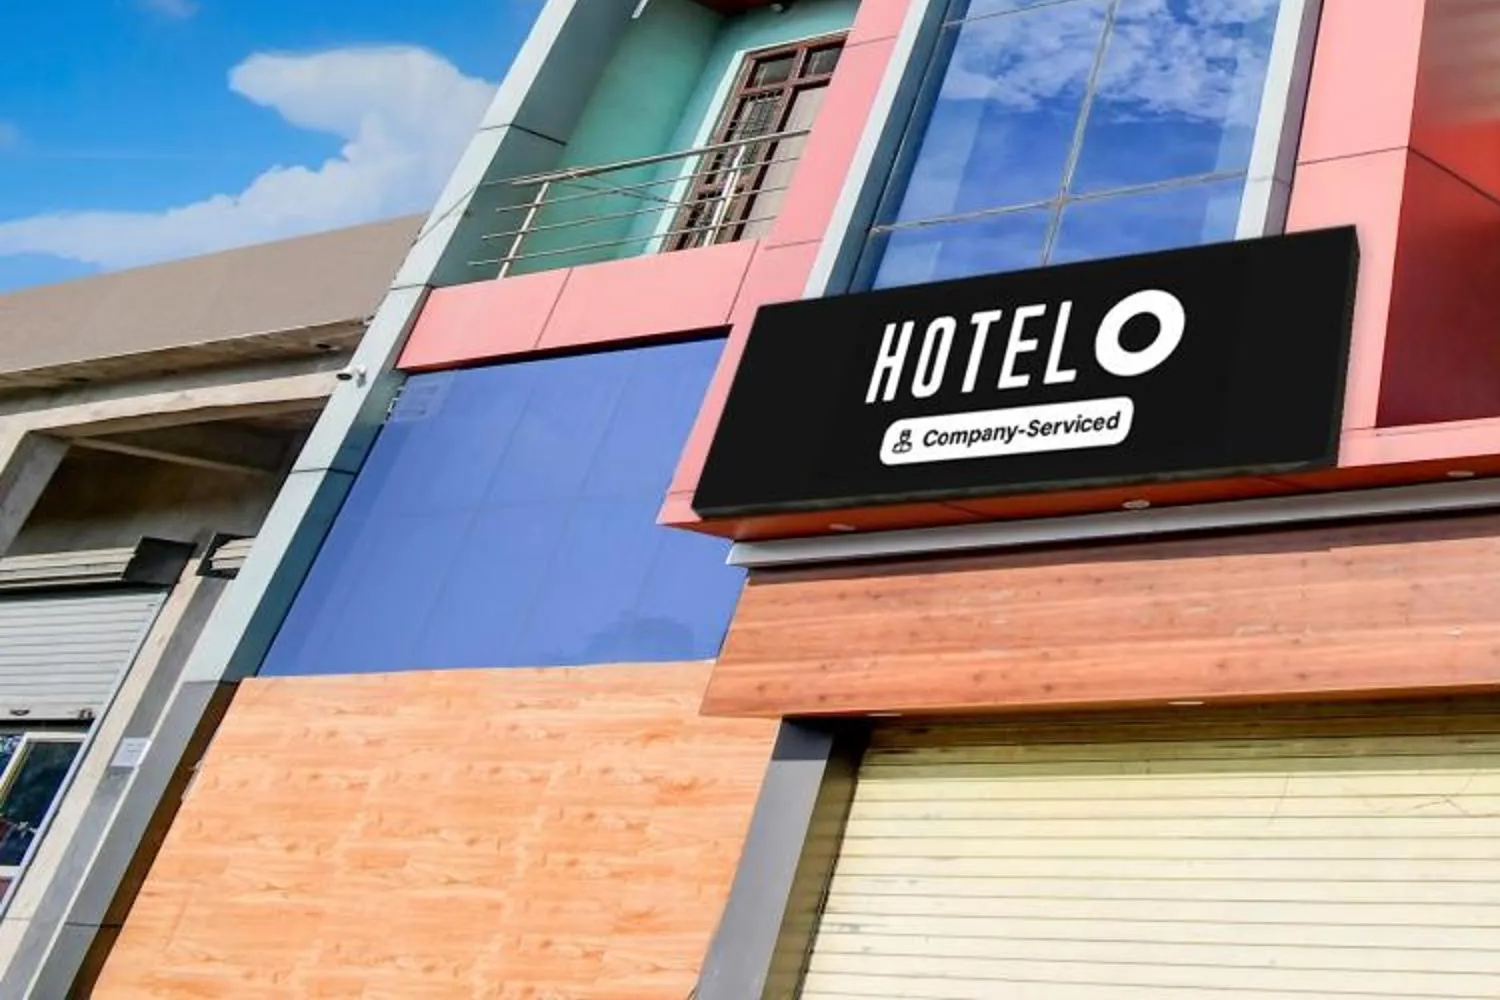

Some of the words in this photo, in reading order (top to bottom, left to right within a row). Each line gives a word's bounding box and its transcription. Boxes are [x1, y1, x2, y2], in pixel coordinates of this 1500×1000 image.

[865, 300, 1077, 404] HOTEL
[1095, 289, 1186, 377] O
[922, 410, 1121, 448] Company-Serviced
